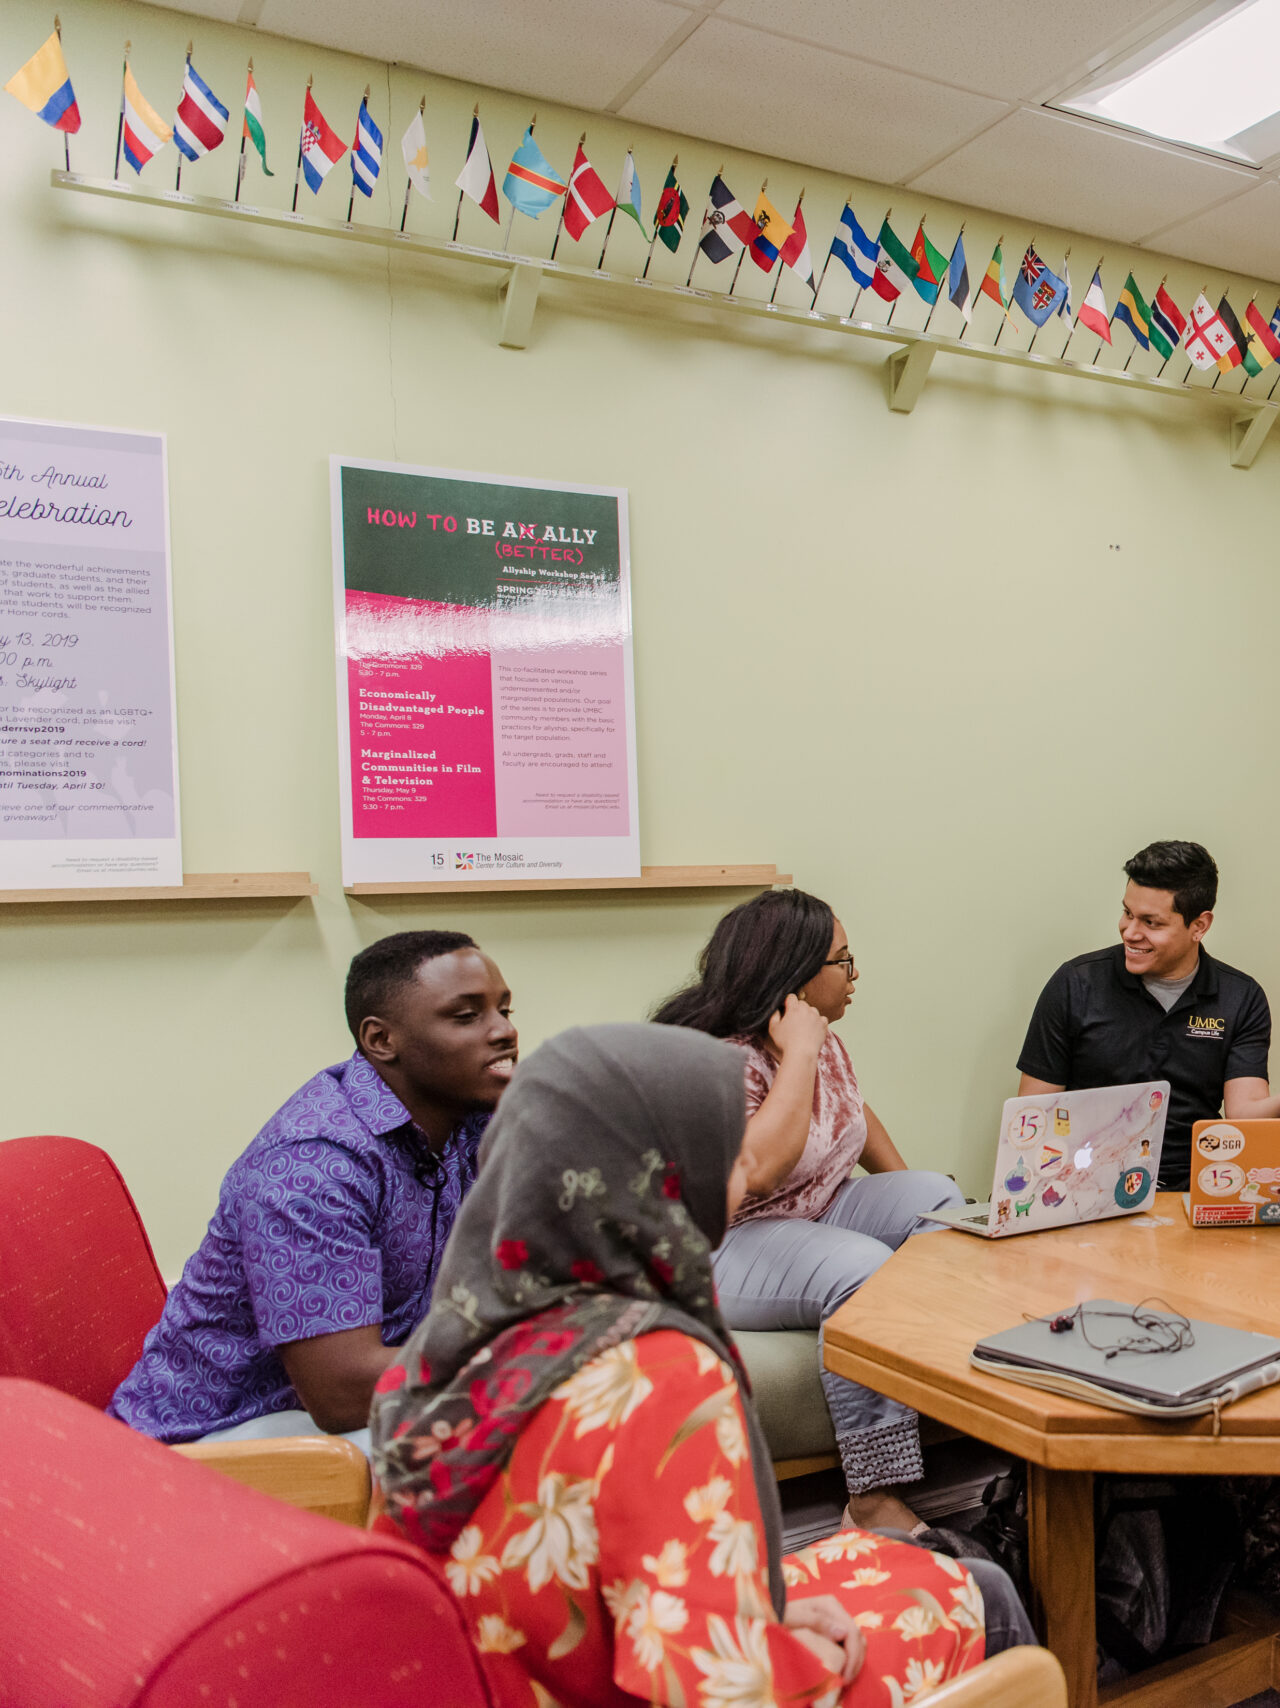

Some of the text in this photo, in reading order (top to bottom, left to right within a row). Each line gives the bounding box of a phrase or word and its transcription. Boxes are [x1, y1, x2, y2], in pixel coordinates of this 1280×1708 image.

[31, 466, 108, 489] Annual
[367, 507, 417, 528] HOW
[427, 514, 458, 533] TO
[466, 518, 496, 536] BE
[542, 526, 598, 544] ALLY
[496, 542, 584, 564] (BETTER)
[503, 566, 536, 576] Allyship
[539, 569, 578, 580] Workshop
[359, 688, 435, 701] Economically
[359, 702, 484, 716] Disadvantaged People
[361, 749, 436, 760] Marginalized
[361, 762, 438, 771] Communities
[456, 764, 481, 772] Film
[361, 775, 433, 784] & Television
[430, 853, 444, 865] 15
[476, 853, 524, 861] The Mosaic
[1189, 1016, 1224, 1030] UMBC
[1017, 1115, 1038, 1142] 15
[1222, 1140, 1241, 1150] SGA
[1209, 1170, 1233, 1190] 15
